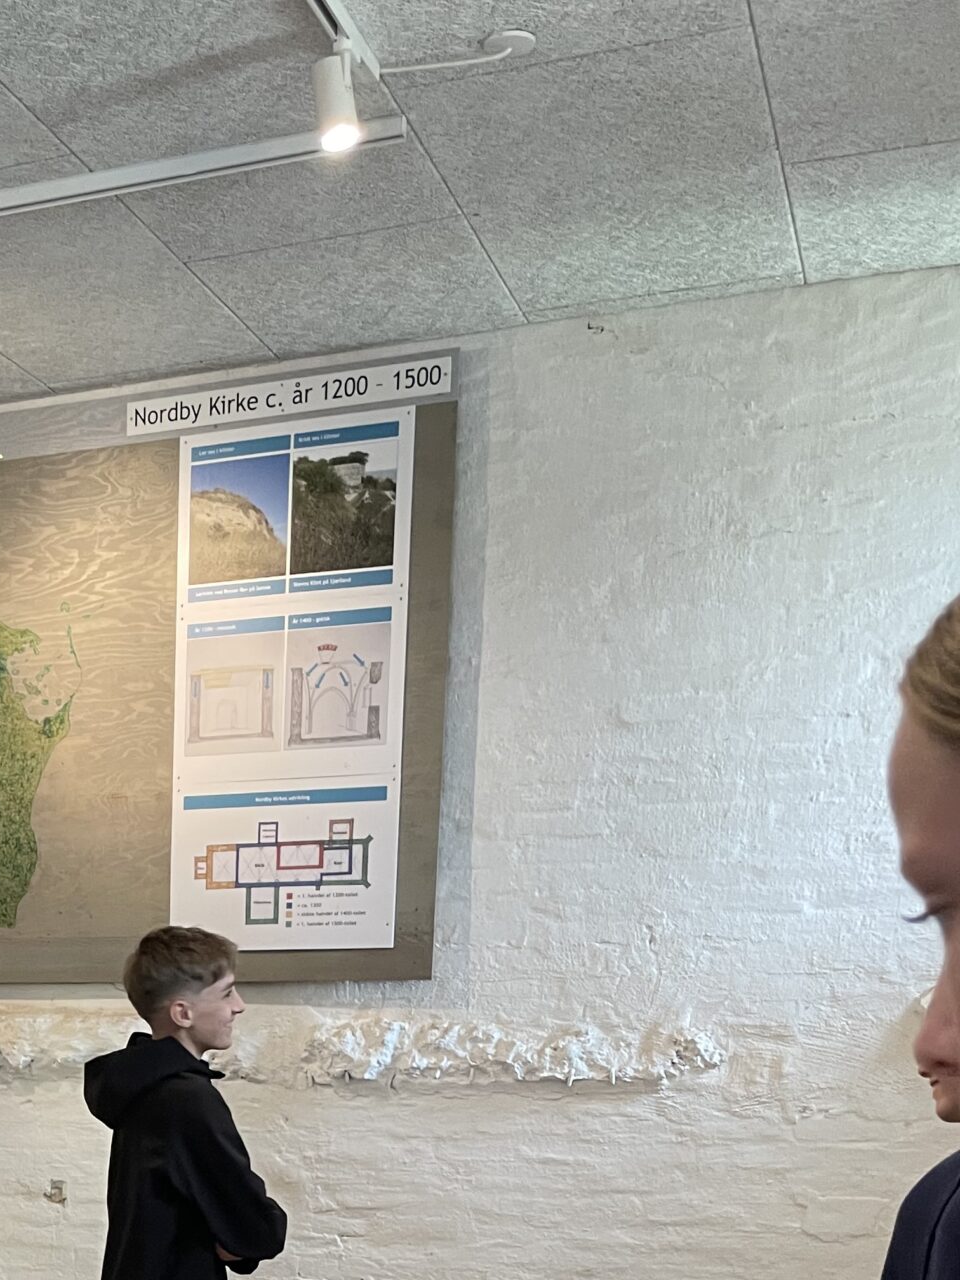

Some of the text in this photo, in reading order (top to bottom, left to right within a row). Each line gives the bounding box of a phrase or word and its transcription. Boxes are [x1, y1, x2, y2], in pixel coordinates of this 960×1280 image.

[134, 401, 202, 427] Nordby
[209, 392, 259, 417] Kirke
[266, 393, 283, 408] c.
[292, 381, 313, 405] år
[321, 375, 369, 400] 1200
[393, 365, 442, 391] 1500
